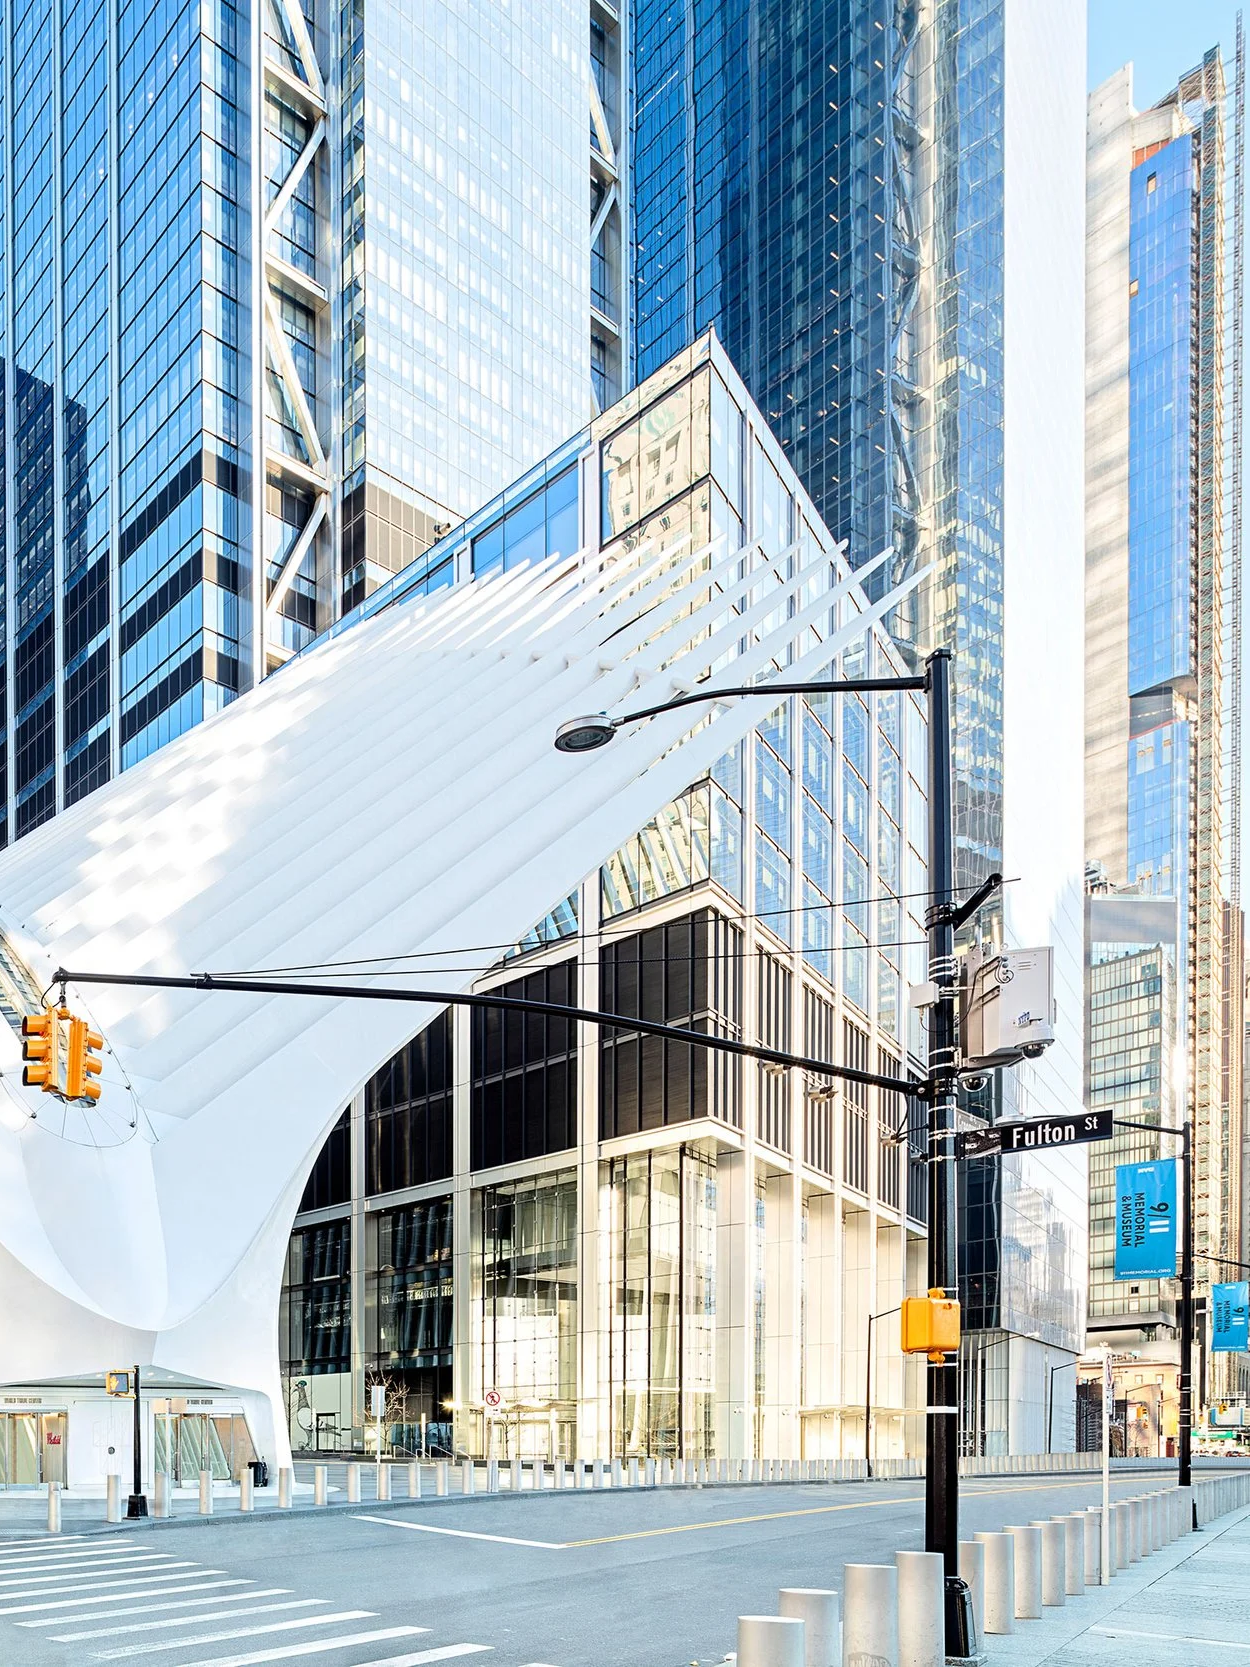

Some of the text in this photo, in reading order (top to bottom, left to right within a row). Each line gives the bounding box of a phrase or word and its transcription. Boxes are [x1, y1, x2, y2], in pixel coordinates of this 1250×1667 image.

[1013, 1116, 1098, 1148] Fulton St
[1134, 1192, 1145, 1248] MEMORIAL
[1148, 1202, 1171, 1233] 9/11
[1223, 1301, 1231, 1333] MEMORIAL
